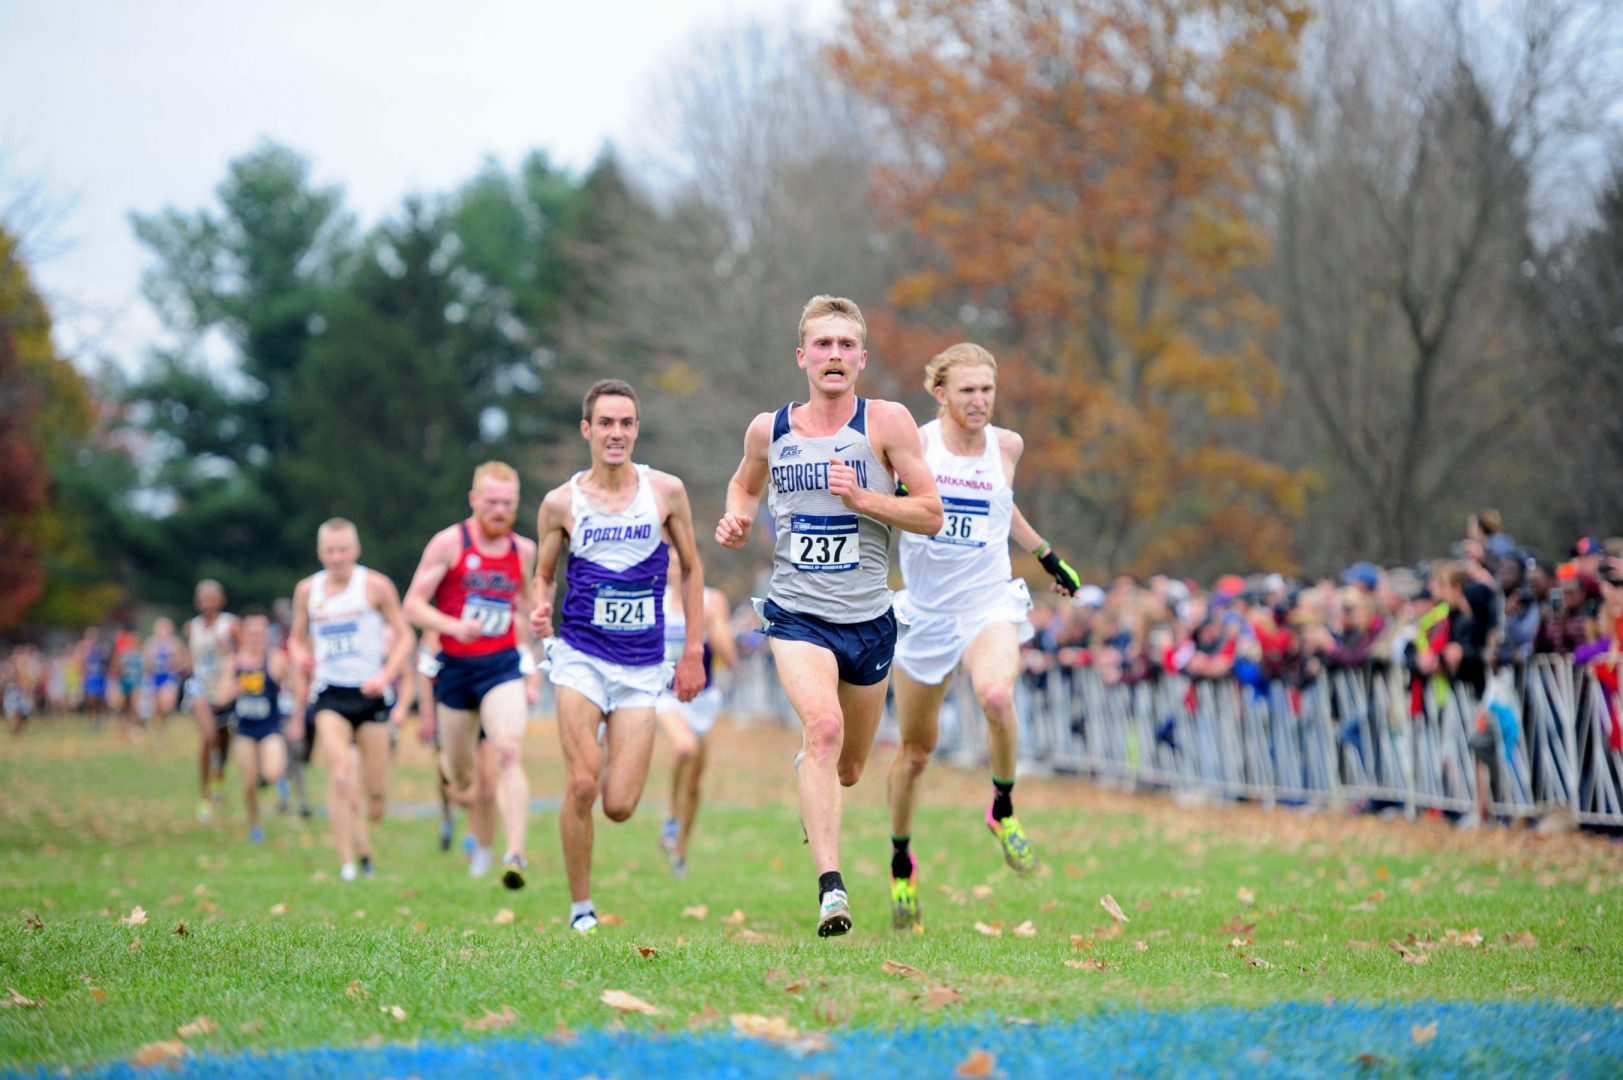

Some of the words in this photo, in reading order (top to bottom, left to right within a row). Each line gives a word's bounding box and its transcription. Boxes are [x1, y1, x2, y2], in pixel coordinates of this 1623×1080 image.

[780, 450, 803, 458] EAST
[771, 460, 868, 494] GEORGETN
[936, 475, 993, 491] ARKANSAS
[583, 524, 652, 546] PORTLAND
[945, 515, 972, 539] 36
[800, 536, 847, 563] 237
[604, 601, 645, 624] 524
